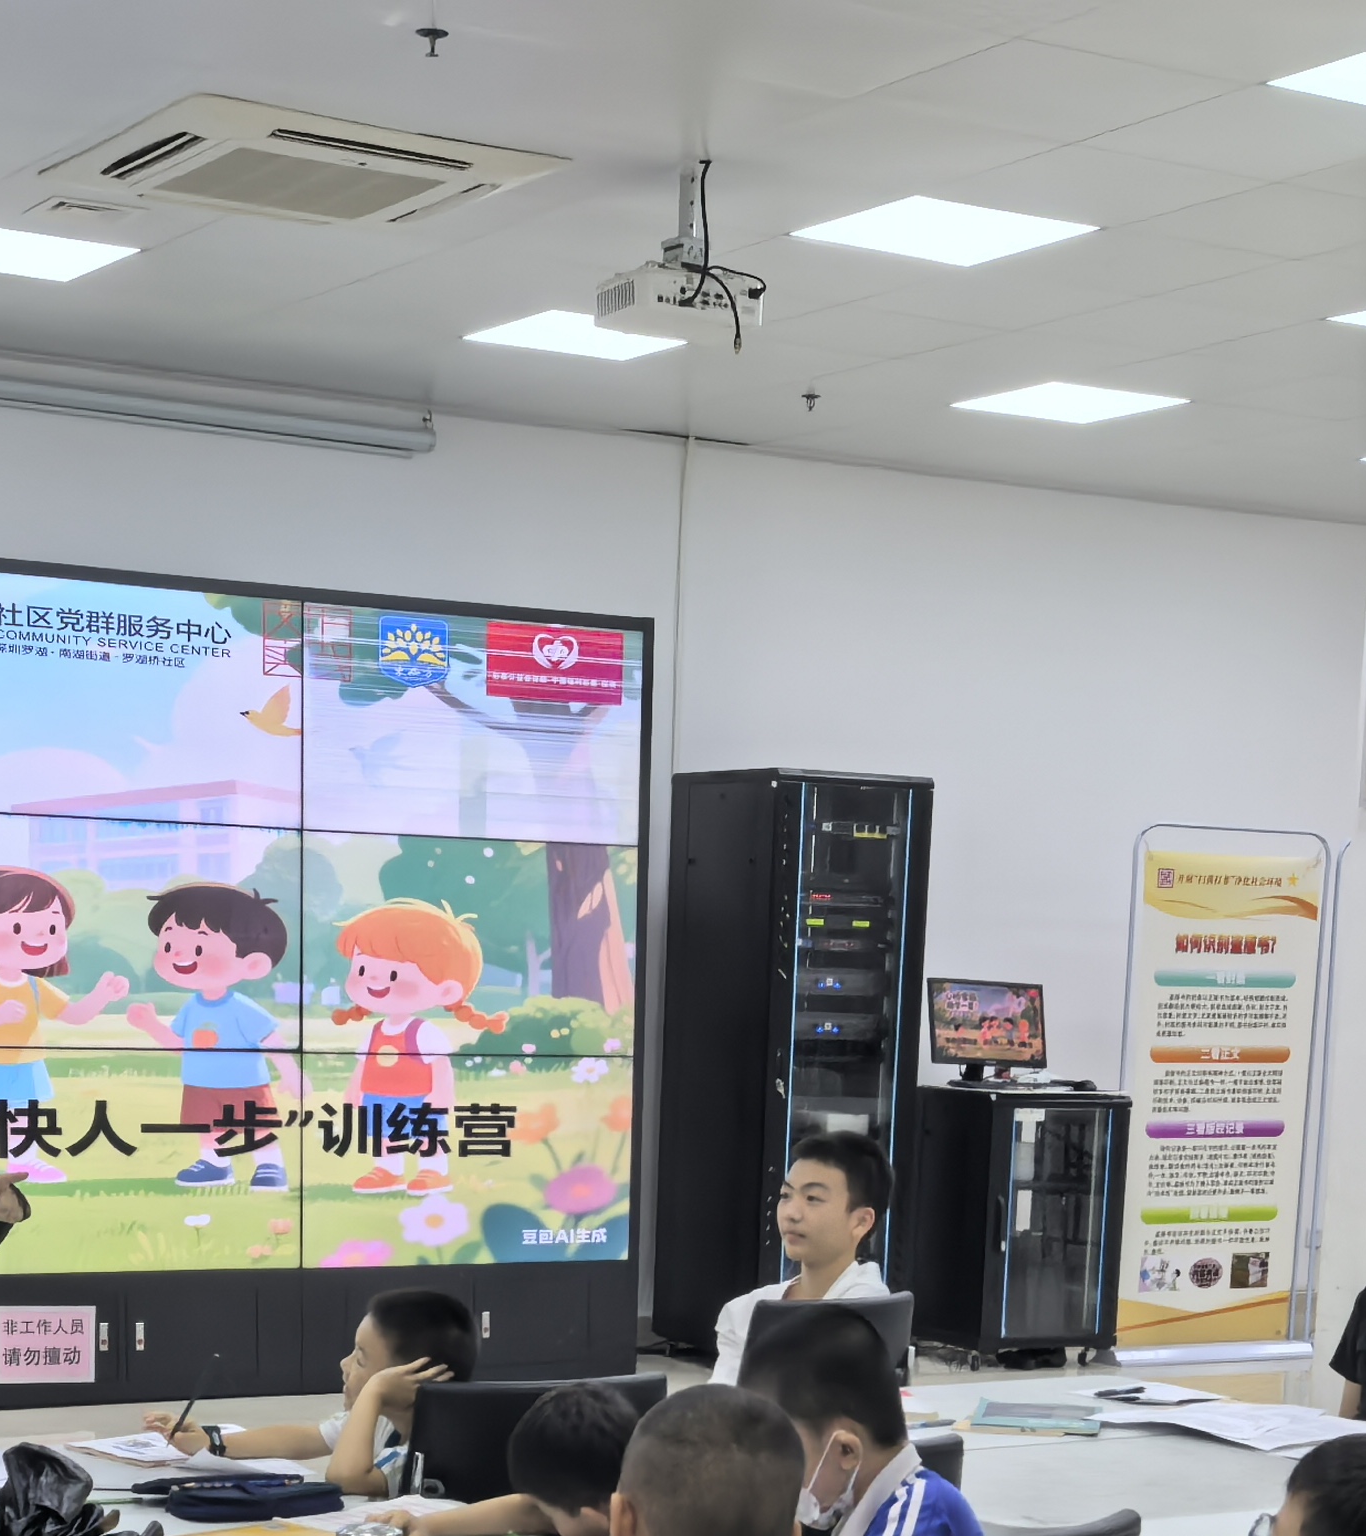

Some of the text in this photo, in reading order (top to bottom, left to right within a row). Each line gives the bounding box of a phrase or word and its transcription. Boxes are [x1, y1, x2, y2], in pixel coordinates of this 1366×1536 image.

[97, 637, 164, 653] SERVICE
[169, 643, 231, 658] CENTER
[522, 1228, 607, 1245] 豆包AI生成
[2, 1318, 85, 1337] 非工作人员
[1, 1346, 82, 1368] 请勿擅动
